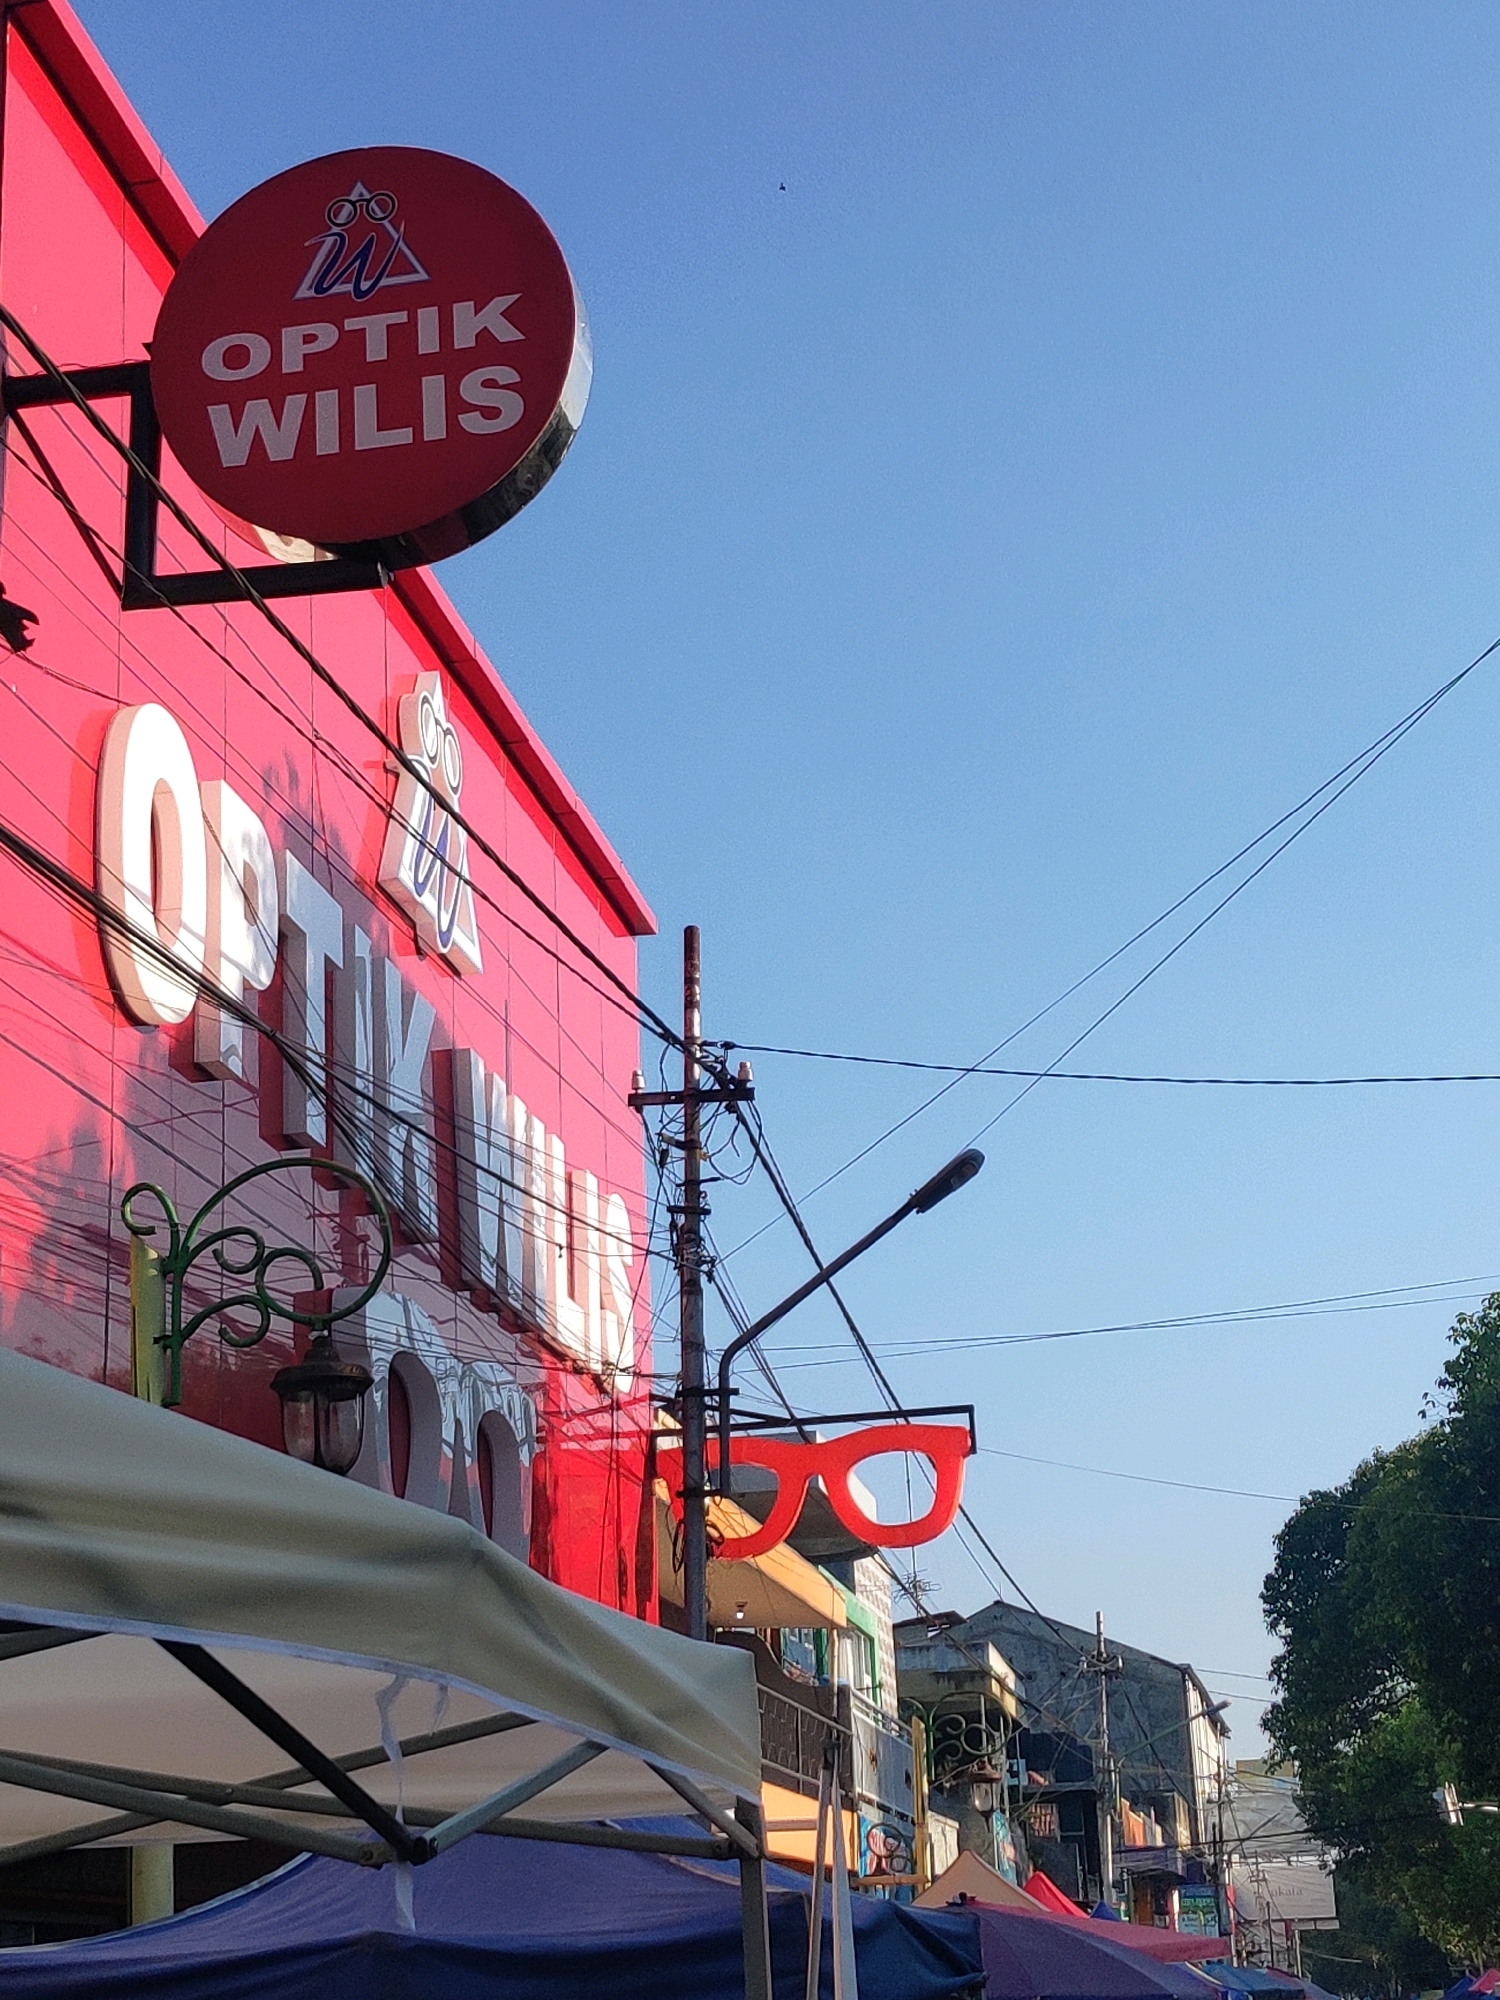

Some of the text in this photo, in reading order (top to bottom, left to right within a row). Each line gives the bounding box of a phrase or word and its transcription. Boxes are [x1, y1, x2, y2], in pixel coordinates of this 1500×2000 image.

[201, 294, 526, 381] OPTIK
[206, 366, 525, 468] WILIS
[97, 703, 439, 1244] OPTIK
[452, 1048, 636, 1394] WILIS
